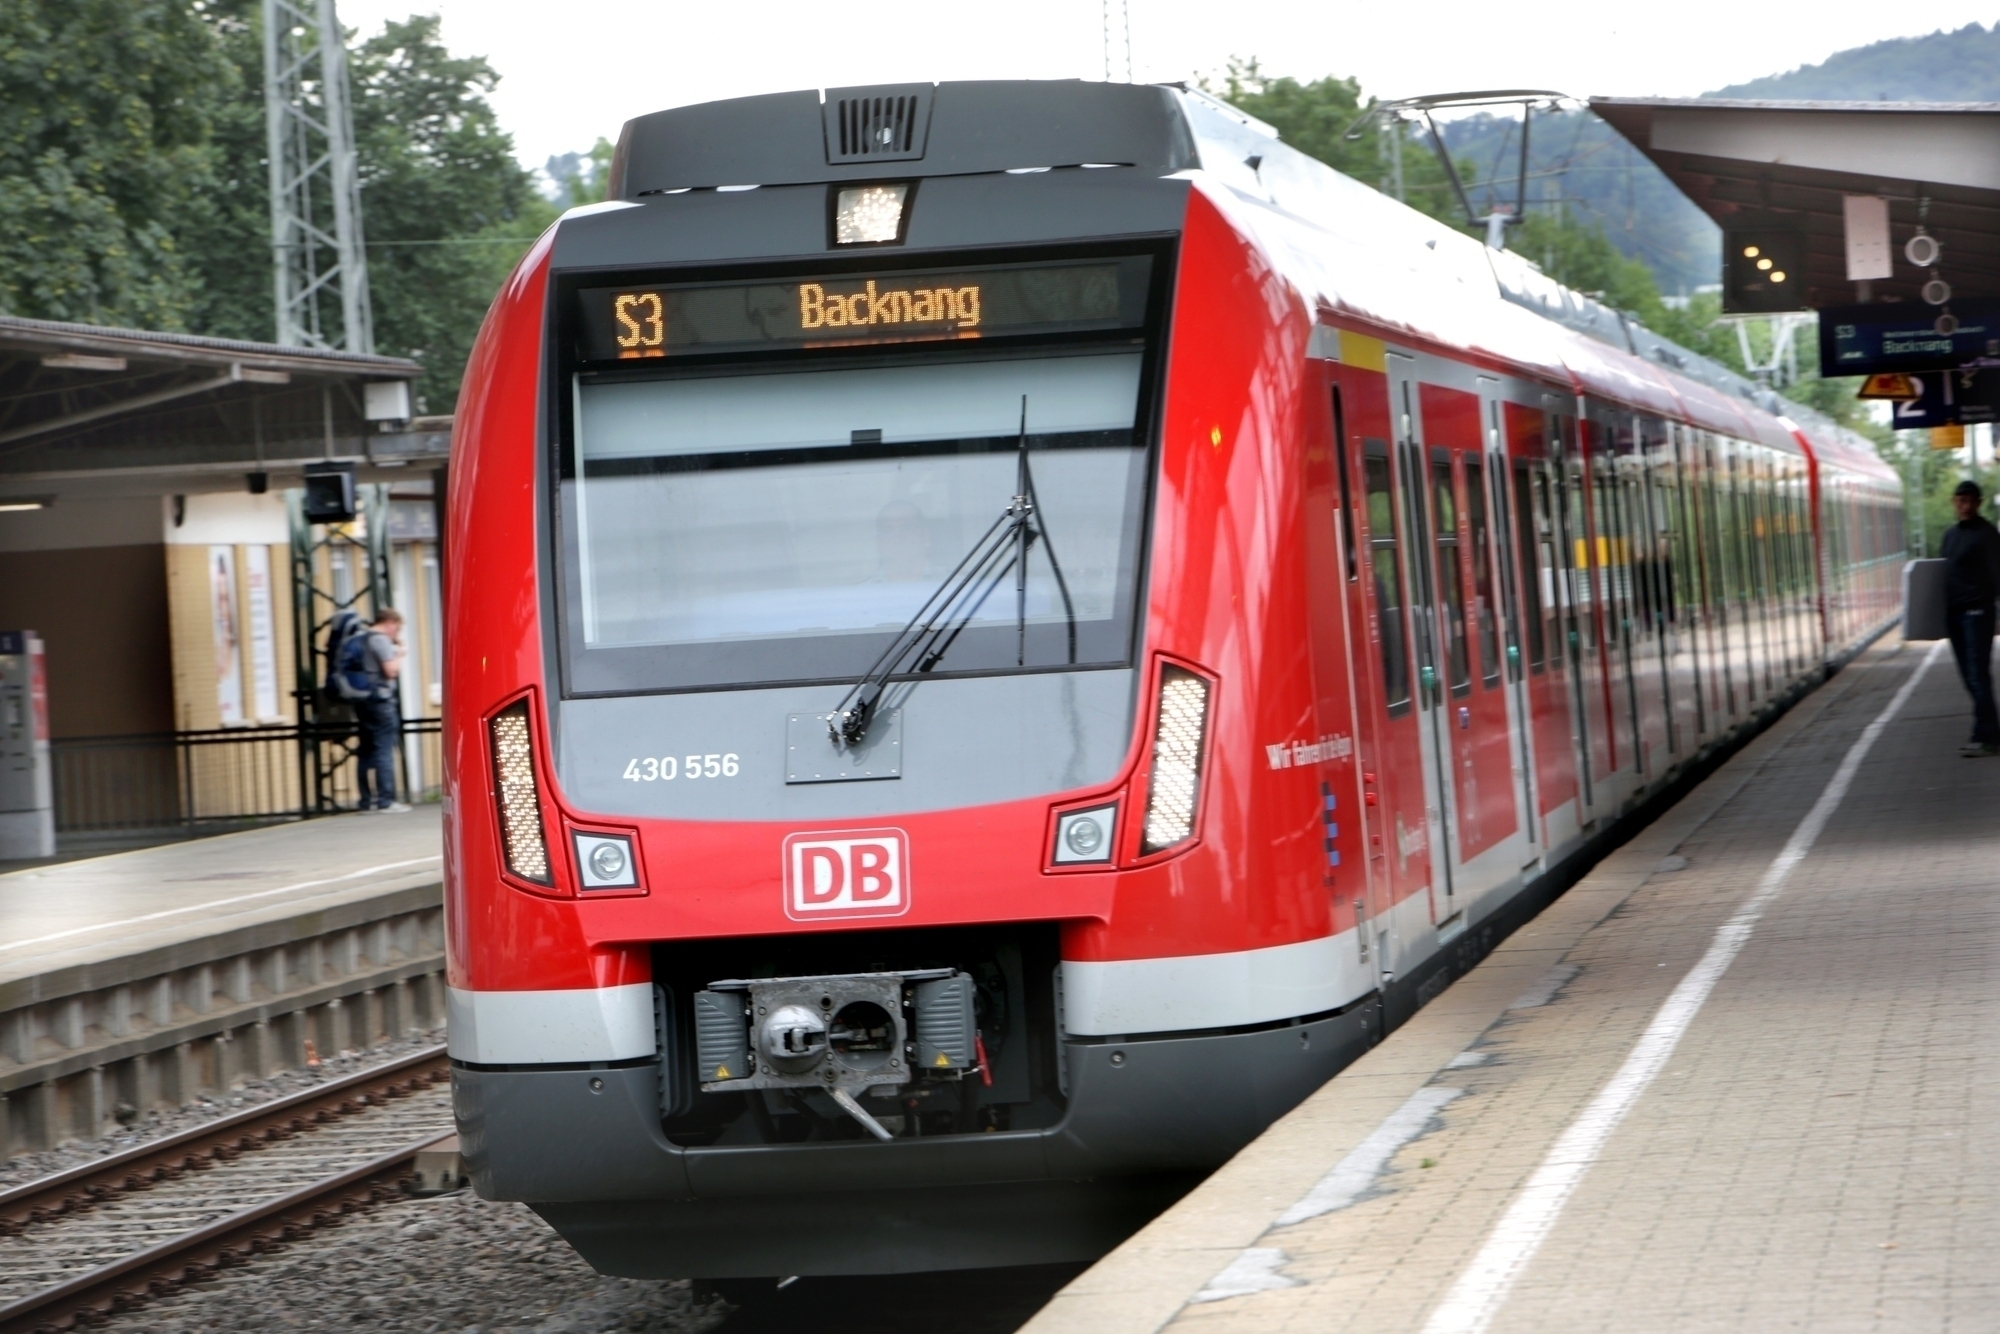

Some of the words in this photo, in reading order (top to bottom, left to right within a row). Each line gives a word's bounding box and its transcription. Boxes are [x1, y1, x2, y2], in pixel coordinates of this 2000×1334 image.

[615, 293, 664, 347] S3
[799, 280, 982, 328] Backnang
[1834, 324, 1857, 339] S3
[1882, 339, 1954, 354] Backnang
[1897, 375, 1927, 418] 2
[623, 757, 678, 782] 430
[685, 753, 740, 779] 556
[799, 843, 893, 904] DB
